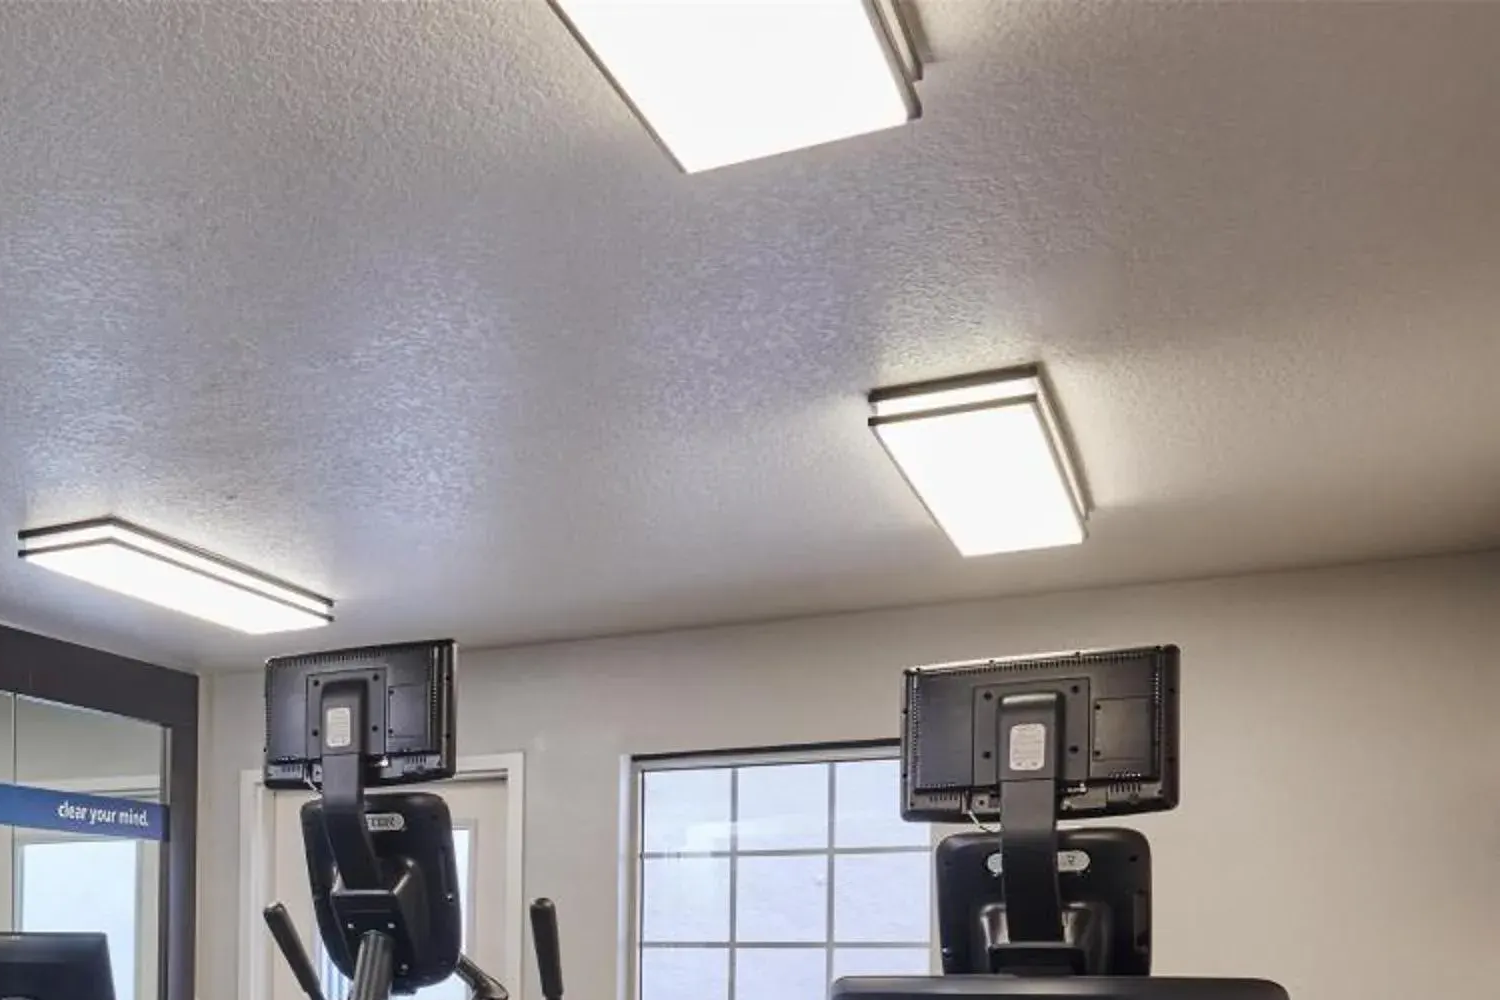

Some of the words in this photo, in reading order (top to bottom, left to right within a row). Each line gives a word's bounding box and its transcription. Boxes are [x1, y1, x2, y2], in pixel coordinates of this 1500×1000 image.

[57, 800, 88, 821] clear
[89, 808, 117, 825] your
[118, 807, 149, 827] mind.
